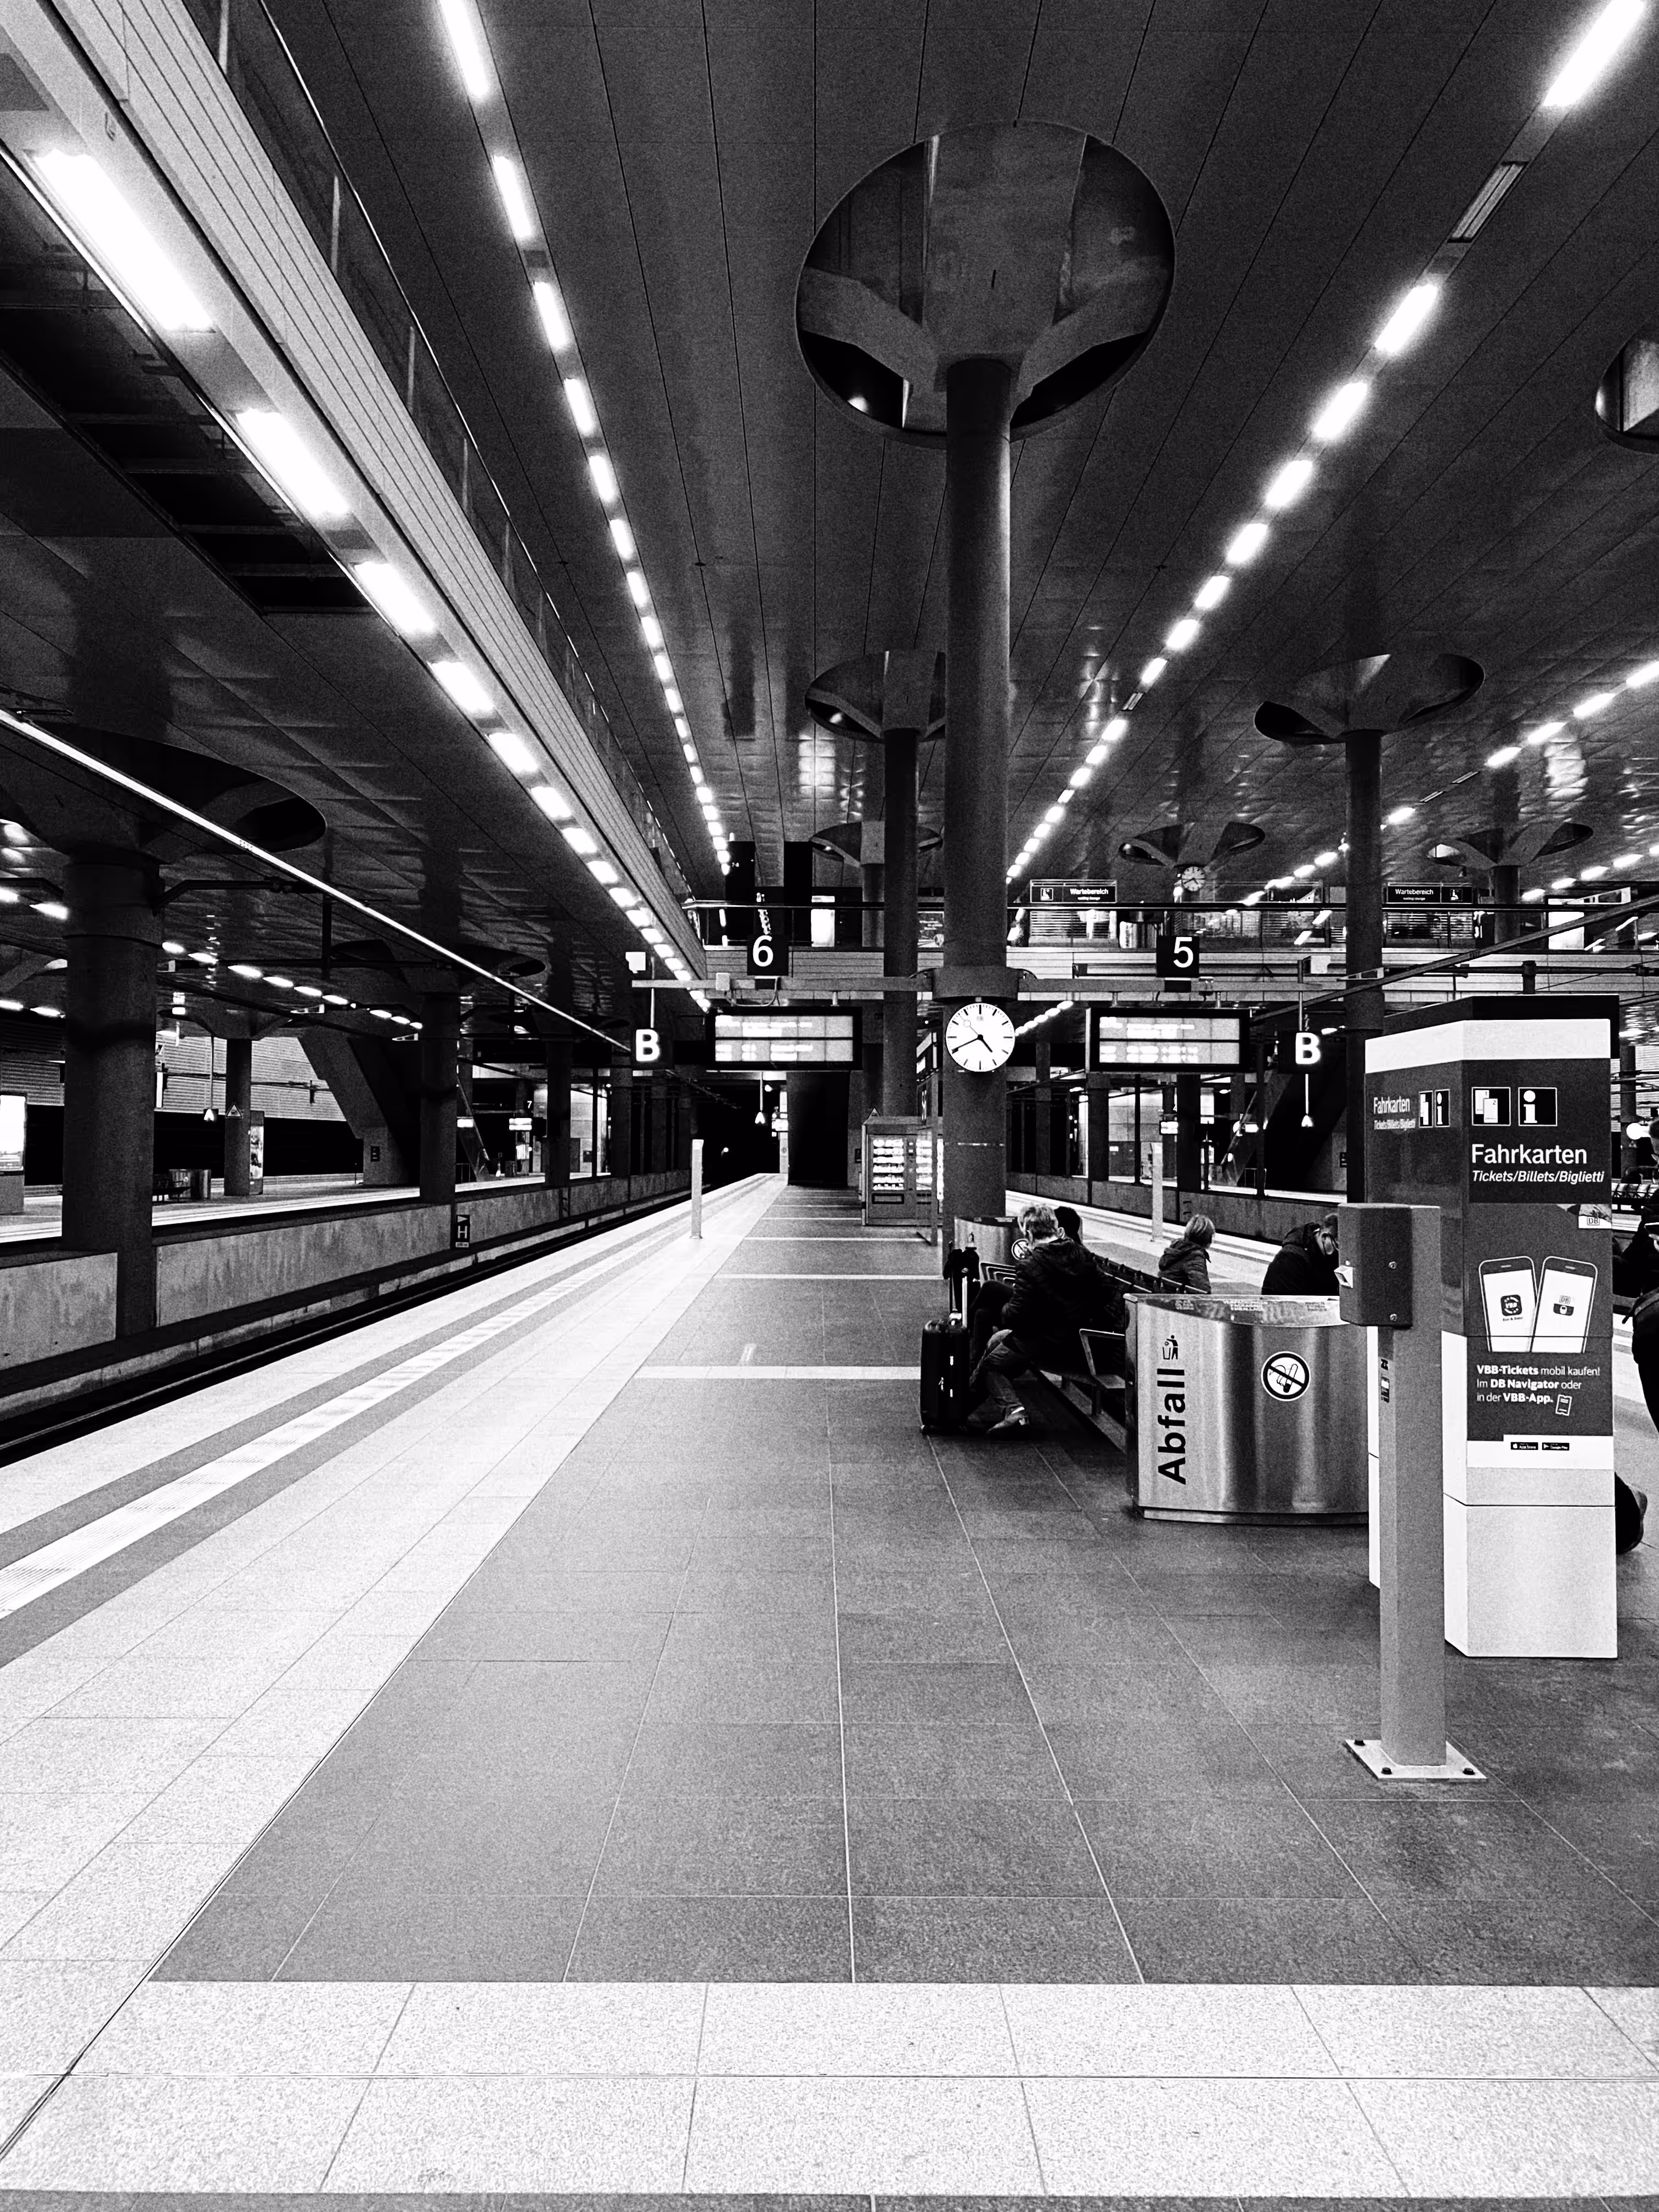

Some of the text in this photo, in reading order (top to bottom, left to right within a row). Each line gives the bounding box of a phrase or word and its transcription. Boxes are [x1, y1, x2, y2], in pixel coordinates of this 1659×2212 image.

[753, 935, 774, 967] 6
[1173, 936, 1194, 968] 5
[636, 1029, 660, 1062] B
[1295, 1032, 1321, 1064] B
[1374, 1096, 1410, 1114] Fahrkarten
[1472, 1144, 1587, 1164] Fahrkarten
[1472, 1170, 1605, 1185] Tickets/Billets/Biglietti
[458, 1226, 467, 1239] H
[1477, 1364, 1600, 1376] VBB-Tickets mobil kaufen!
[1477, 1379, 1582, 1391] Im DB Navigator oder
[1477, 1392, 1554, 1404] in der VBB-App.
[1156, 1368, 1186, 1485] Abfall
